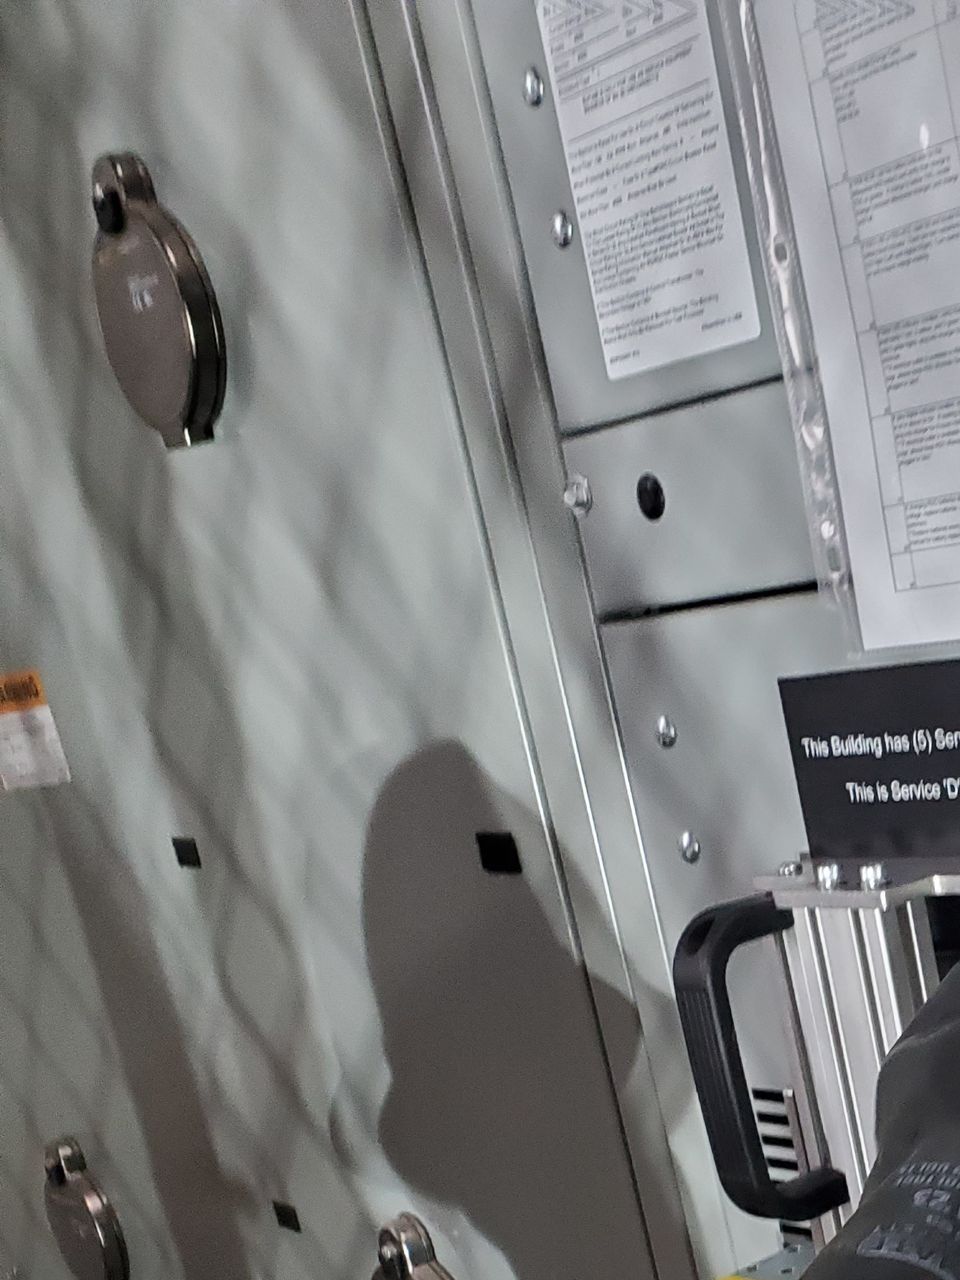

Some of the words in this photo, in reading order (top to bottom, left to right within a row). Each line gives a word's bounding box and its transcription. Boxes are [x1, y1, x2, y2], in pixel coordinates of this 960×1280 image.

[801, 736, 829, 758] This
[831, 733, 883, 759] Building
[884, 731, 910, 753] has
[845, 781, 874, 803] This
[876, 780, 889, 802] is
[890, 778, 941, 802] Service
